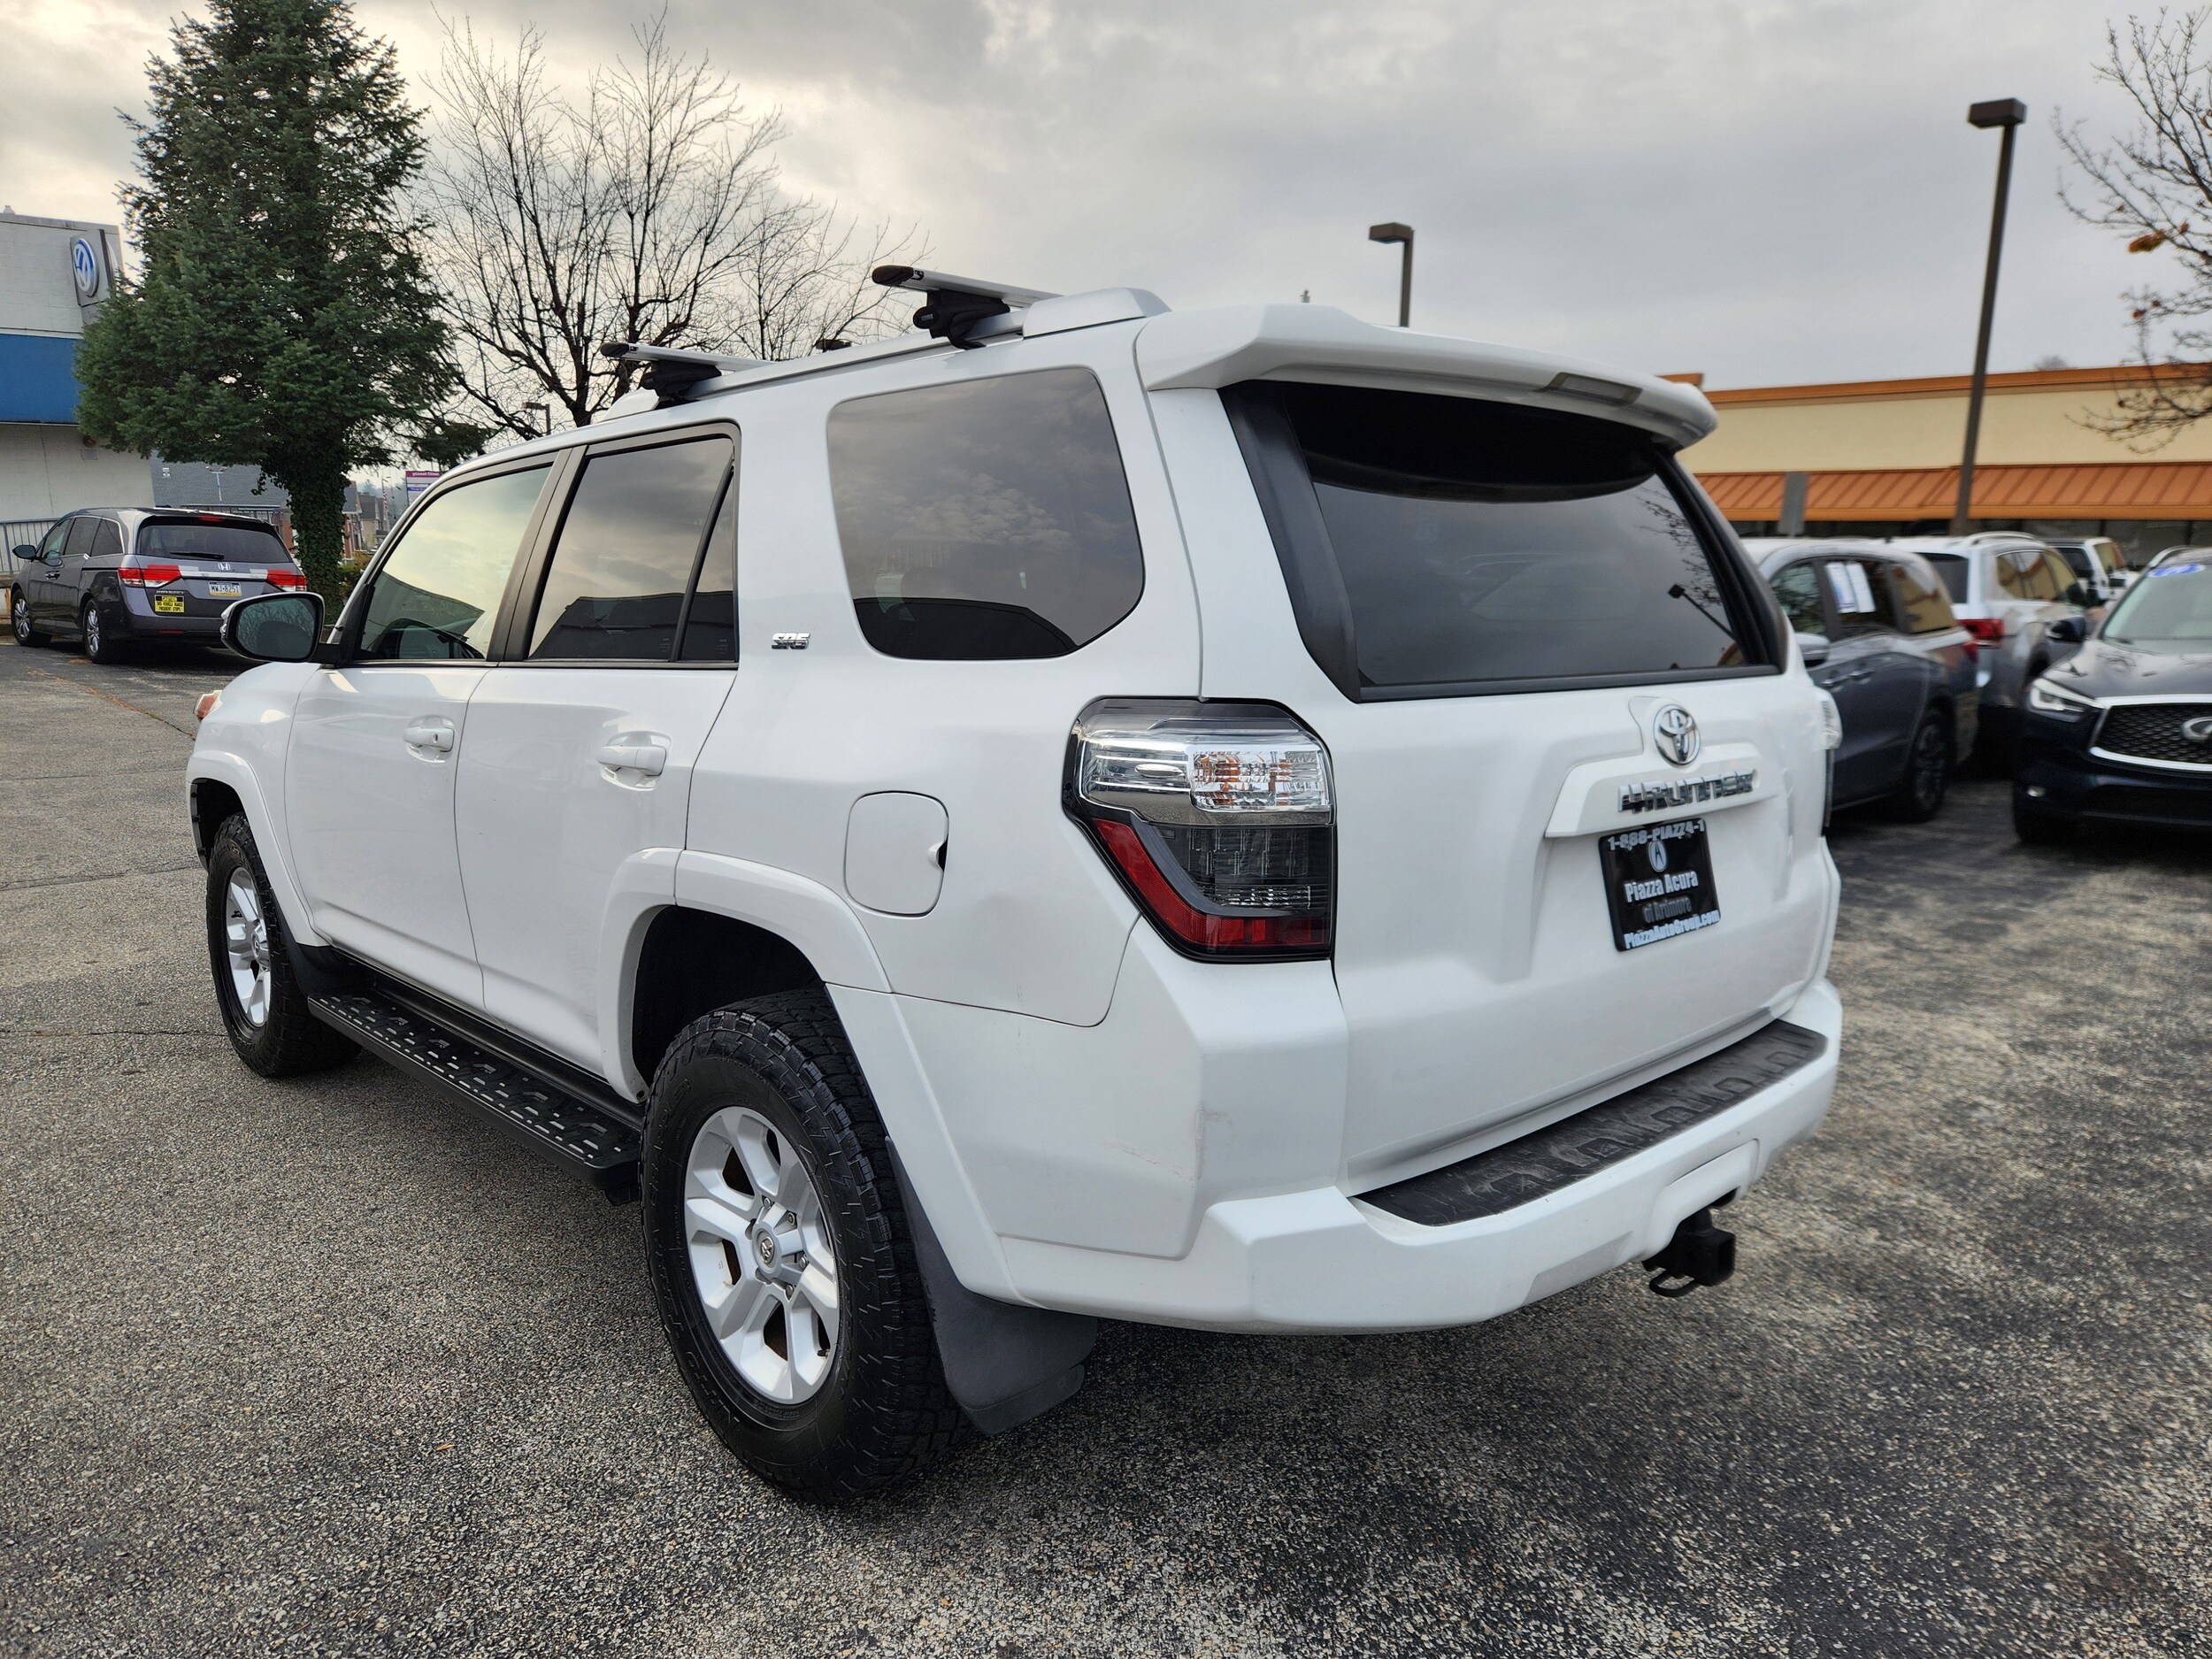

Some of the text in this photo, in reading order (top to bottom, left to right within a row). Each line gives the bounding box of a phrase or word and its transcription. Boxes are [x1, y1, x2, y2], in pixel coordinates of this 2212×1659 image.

[772, 632, 810, 649] SR5
[1618, 770, 1754, 814] 4RUNNER
[1624, 870, 1699, 902] Piazza Acura
